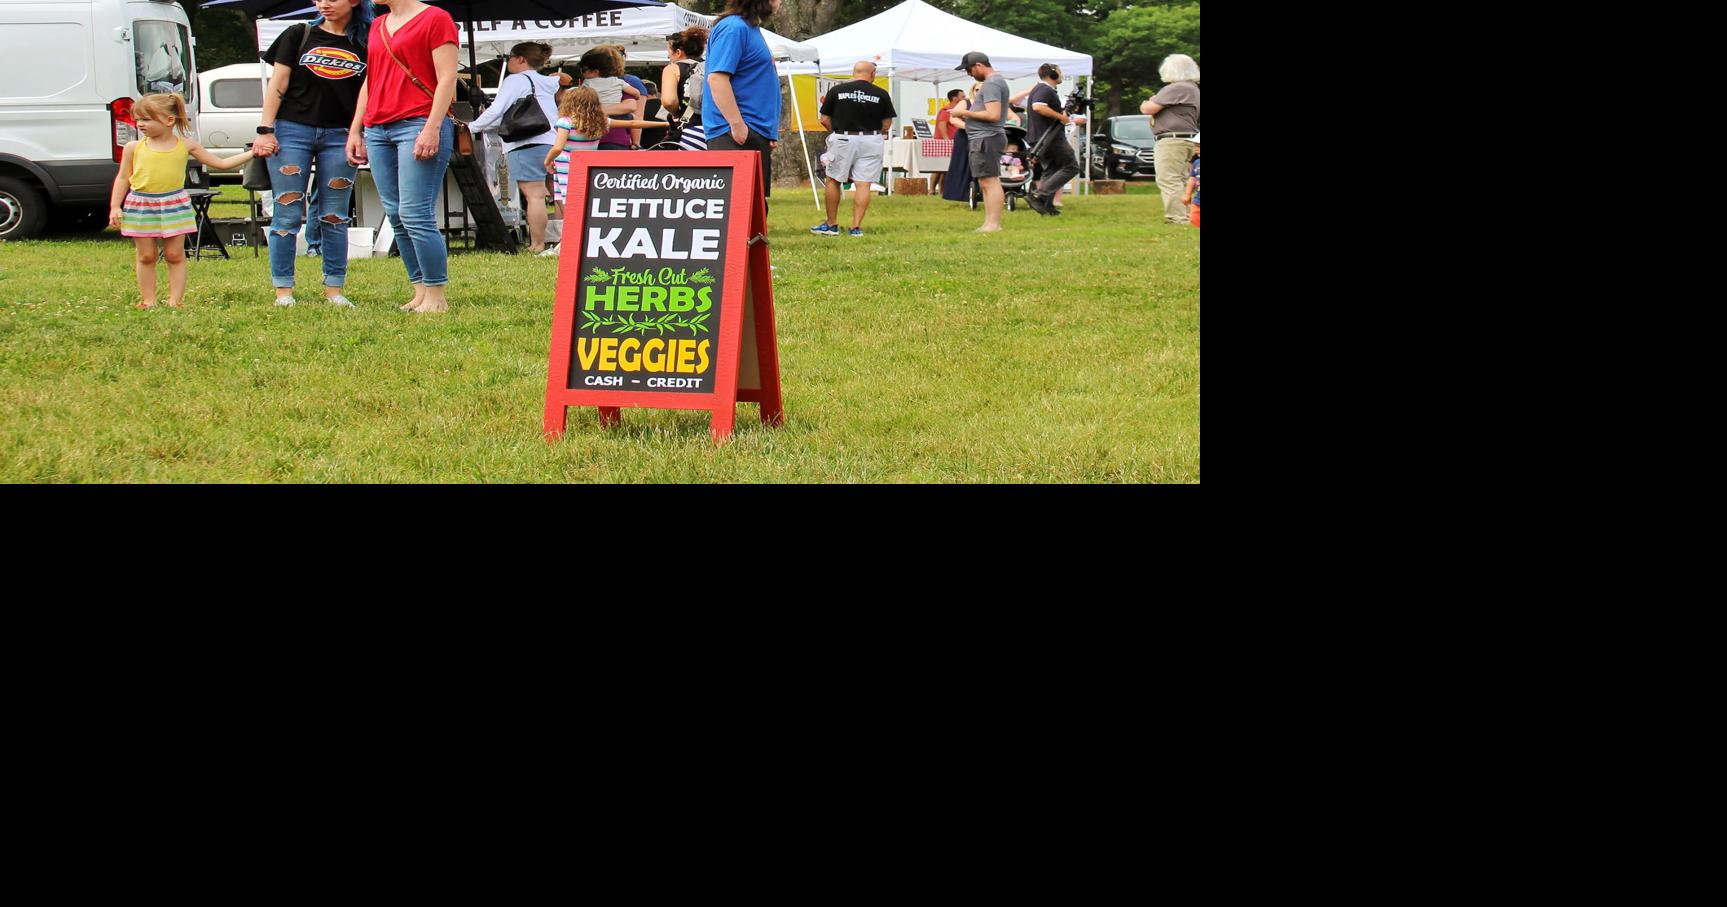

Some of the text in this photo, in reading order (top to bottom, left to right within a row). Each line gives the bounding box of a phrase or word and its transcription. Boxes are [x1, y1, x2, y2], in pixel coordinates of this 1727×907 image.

[535, 11, 623, 29] COFFEE
[303, 55, 362, 70] Dickies
[593, 172, 726, 194] Certified Organic
[591, 198, 725, 219] LETTUCE
[586, 227, 721, 260] KALE
[610, 266, 689, 286] Fresh Cut
[584, 285, 713, 313] HERBS
[577, 336, 711, 375] VEGGIES
[584, 375, 624, 386] CASH
[646, 377, 703, 389] CREDIT
